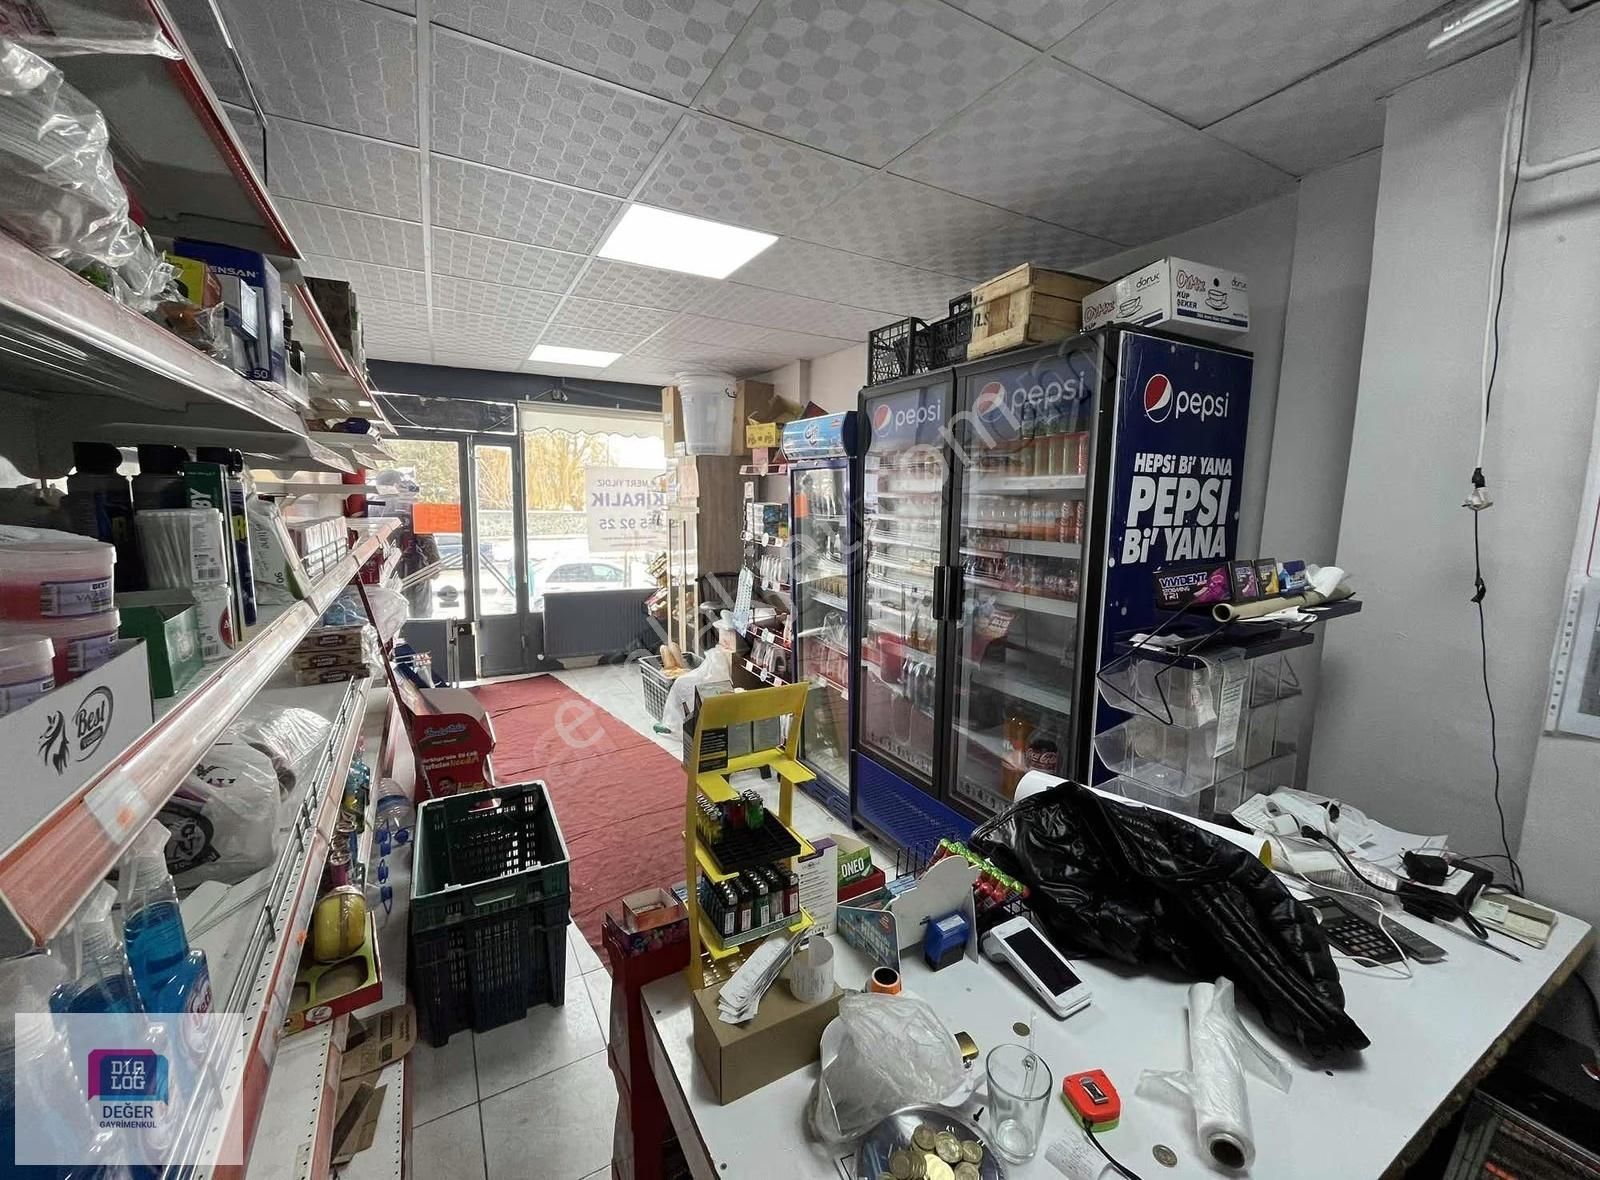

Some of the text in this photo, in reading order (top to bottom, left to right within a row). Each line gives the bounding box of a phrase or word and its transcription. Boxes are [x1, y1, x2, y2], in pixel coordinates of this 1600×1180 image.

[209, 265, 256, 278] ENSAN
[1011, 371, 1085, 412] pepsi
[1175, 391, 1230, 423] pepsi
[895, 399, 942, 432] pepsi
[1199, 456, 1233, 477] YANA
[1126, 475, 1232, 528] PEPSI
[1164, 526, 1227, 562] YANA
